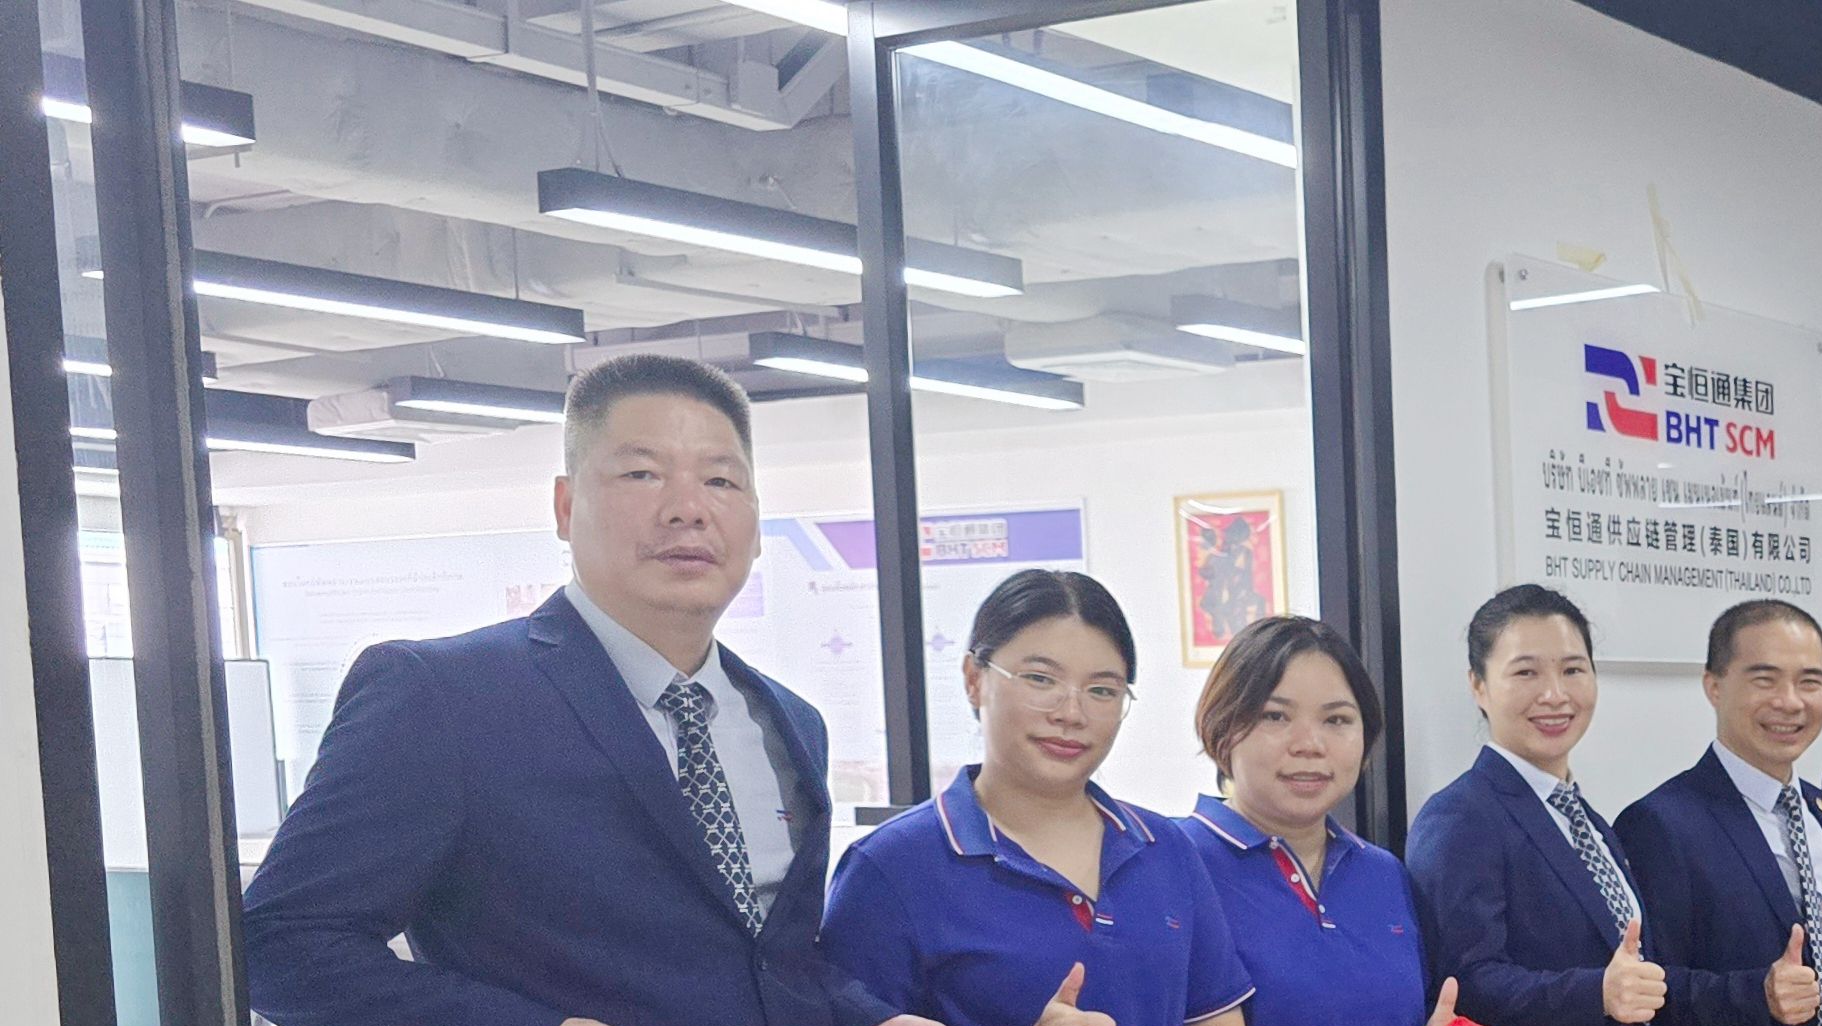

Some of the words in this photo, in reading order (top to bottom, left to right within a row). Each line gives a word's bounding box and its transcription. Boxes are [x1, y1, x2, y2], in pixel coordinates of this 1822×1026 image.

[1664, 363, 1775, 415] 宝恒通集团
[1666, 410, 1720, 450] BHT
[1726, 422, 1775, 460] SCM
[1542, 449, 1573, 492] บริษัท
[1546, 555, 1568, 578] BHT
[1572, 557, 1616, 581] SUPPLY
[1619, 561, 1652, 585] CHAIN
